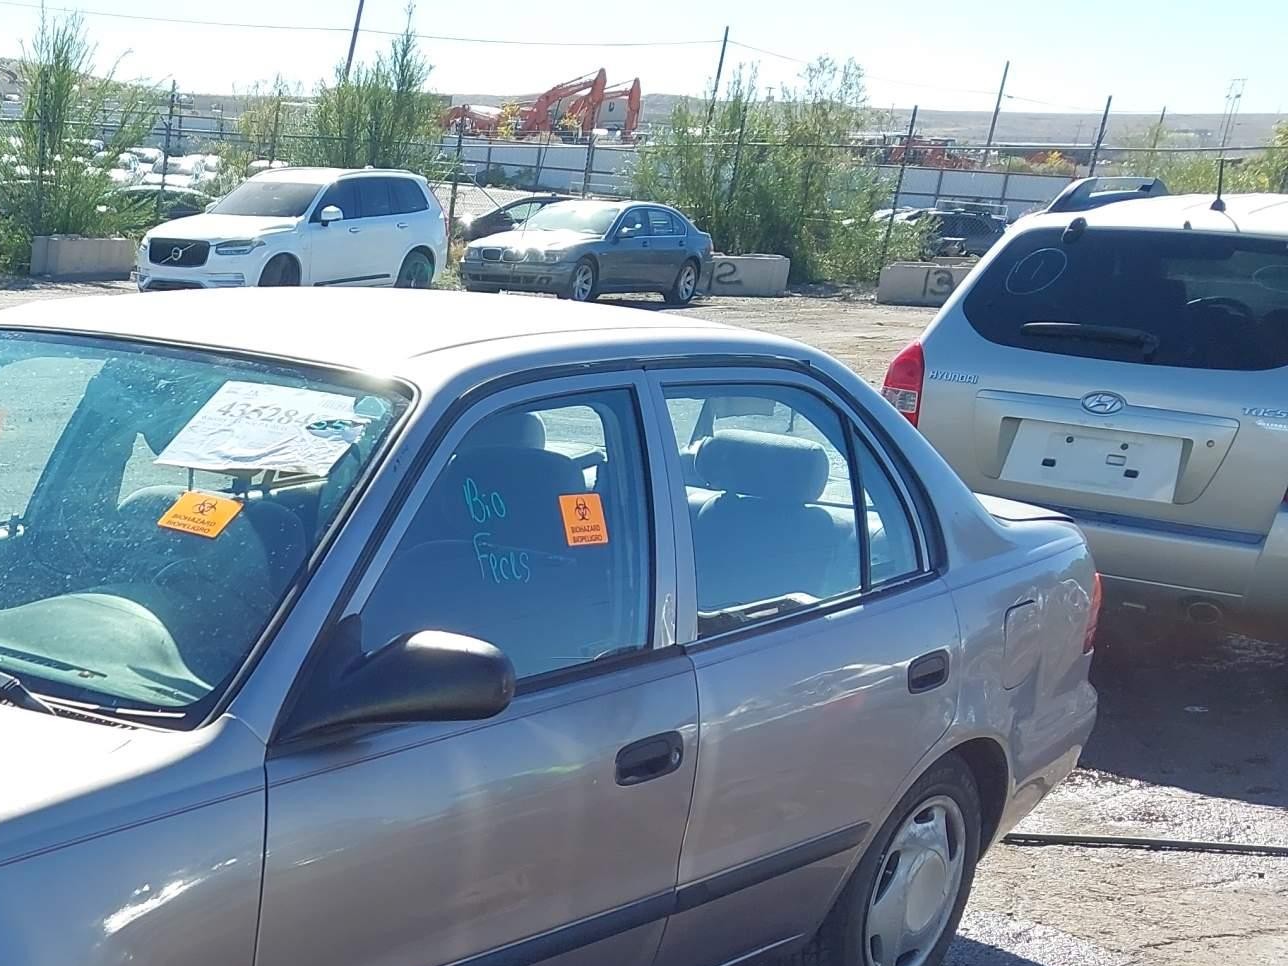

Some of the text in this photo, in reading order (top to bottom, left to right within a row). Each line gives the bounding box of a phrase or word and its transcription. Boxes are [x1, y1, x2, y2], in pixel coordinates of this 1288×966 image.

[922, 268, 955, 297] 13
[929, 369, 979, 385] HYUNDAI
[463, 478, 506, 523] Bio
[570, 524, 601, 533] BIOHAZARD
[573, 534, 603, 543] BIOPELIGRO
